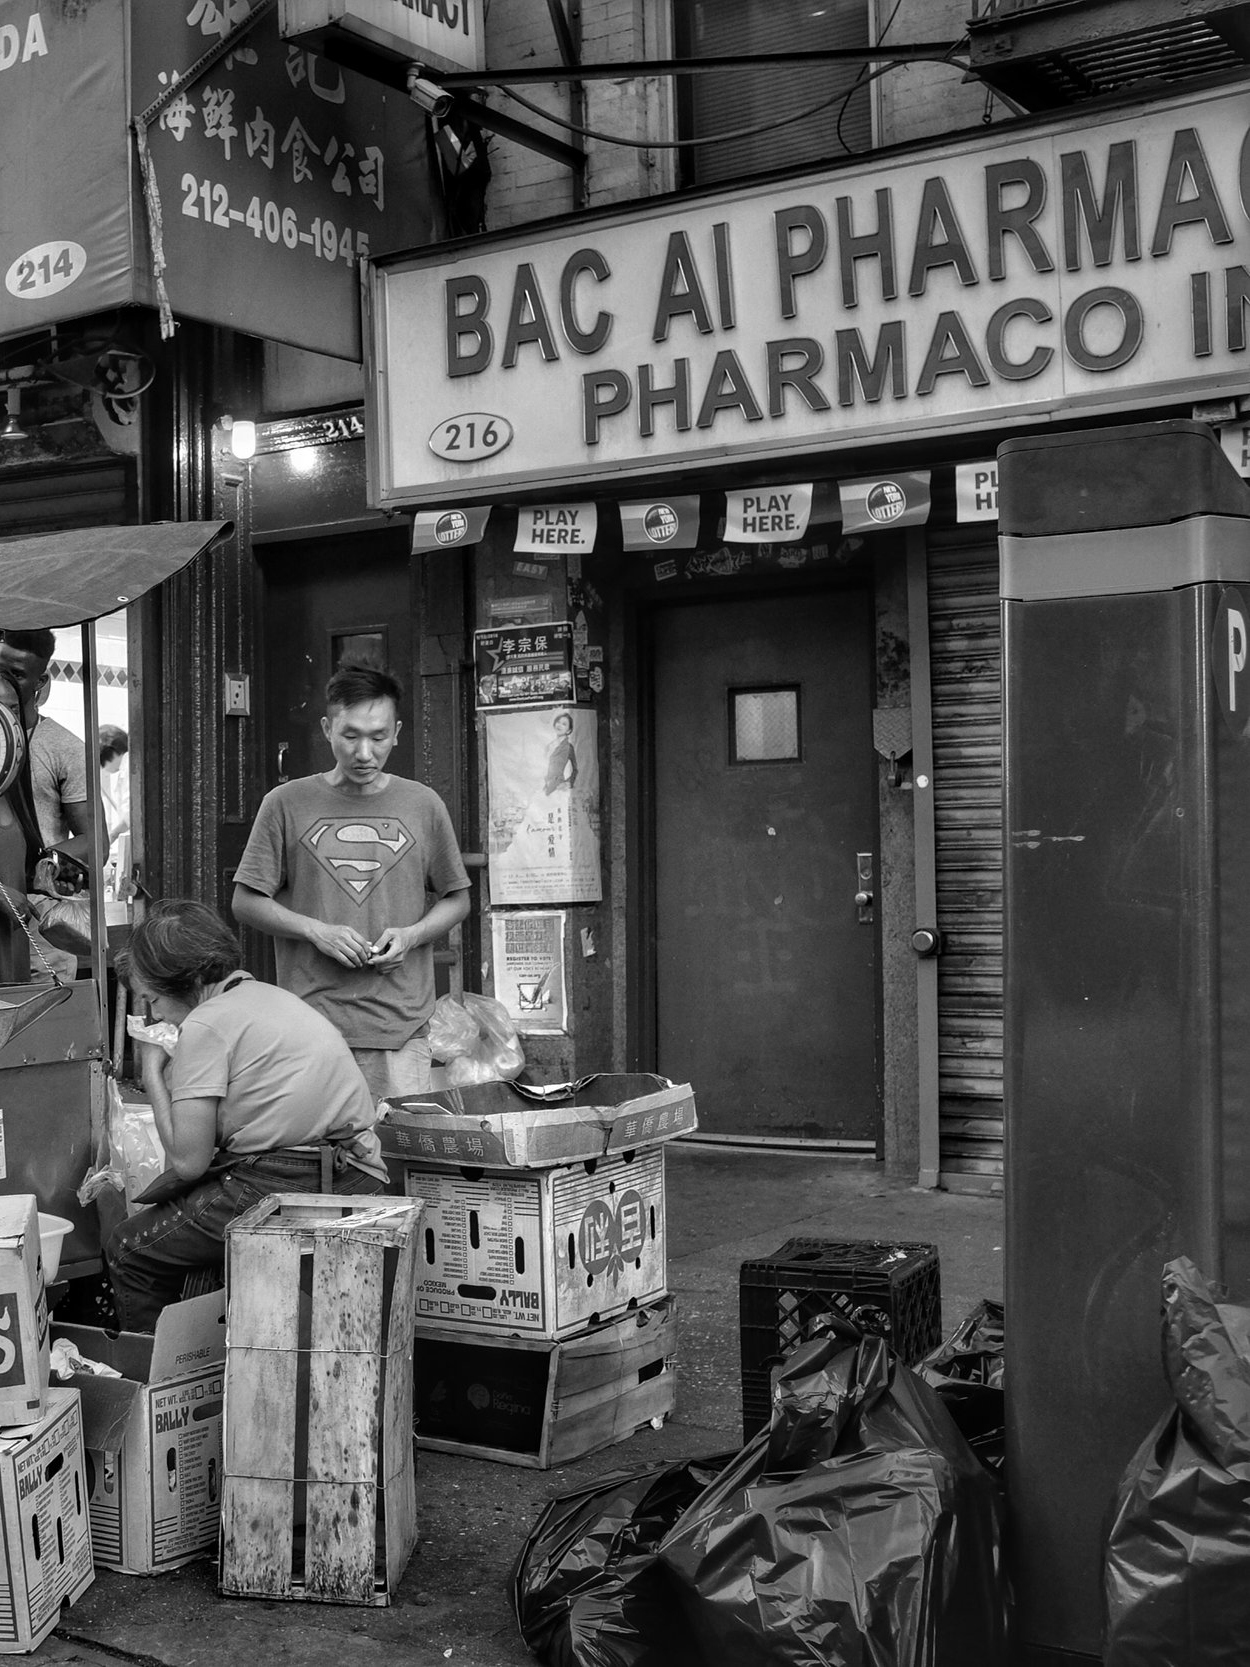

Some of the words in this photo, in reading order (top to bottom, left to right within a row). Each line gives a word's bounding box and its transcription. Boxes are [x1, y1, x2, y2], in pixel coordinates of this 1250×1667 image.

[180, 172, 370, 268] 212-406-1945
[16, 248, 74, 291] 214
[444, 247, 614, 379] BAC
[653, 222, 738, 343] AI
[581, 285, 1146, 446] PHARMACO
[322, 415, 365, 439] 214
[444, 420, 500, 452] 216
[742, 494, 793, 514] PLAY
[532, 509, 579, 526] PLAY
[742, 514, 801, 534] HERE.
[530, 527, 586, 545] HERE.
[502, 635, 548, 654] 李宗保
[423, 1279, 447, 1288] MEXICO
[429, 1286, 456, 1296] PRODUCE
[500, 1289, 540, 1310] BALLY
[512, 1311, 526, 1320] WT.
[525, 1312, 540, 1322] NET
[175, 1346, 211, 1365] PERISHABLE
[155, 1397, 167, 1410] NET
[167, 1394, 179, 1405] WT.
[155, 1405, 190, 1435] BALLY
[18, 1463, 44, 1502] BALLY
